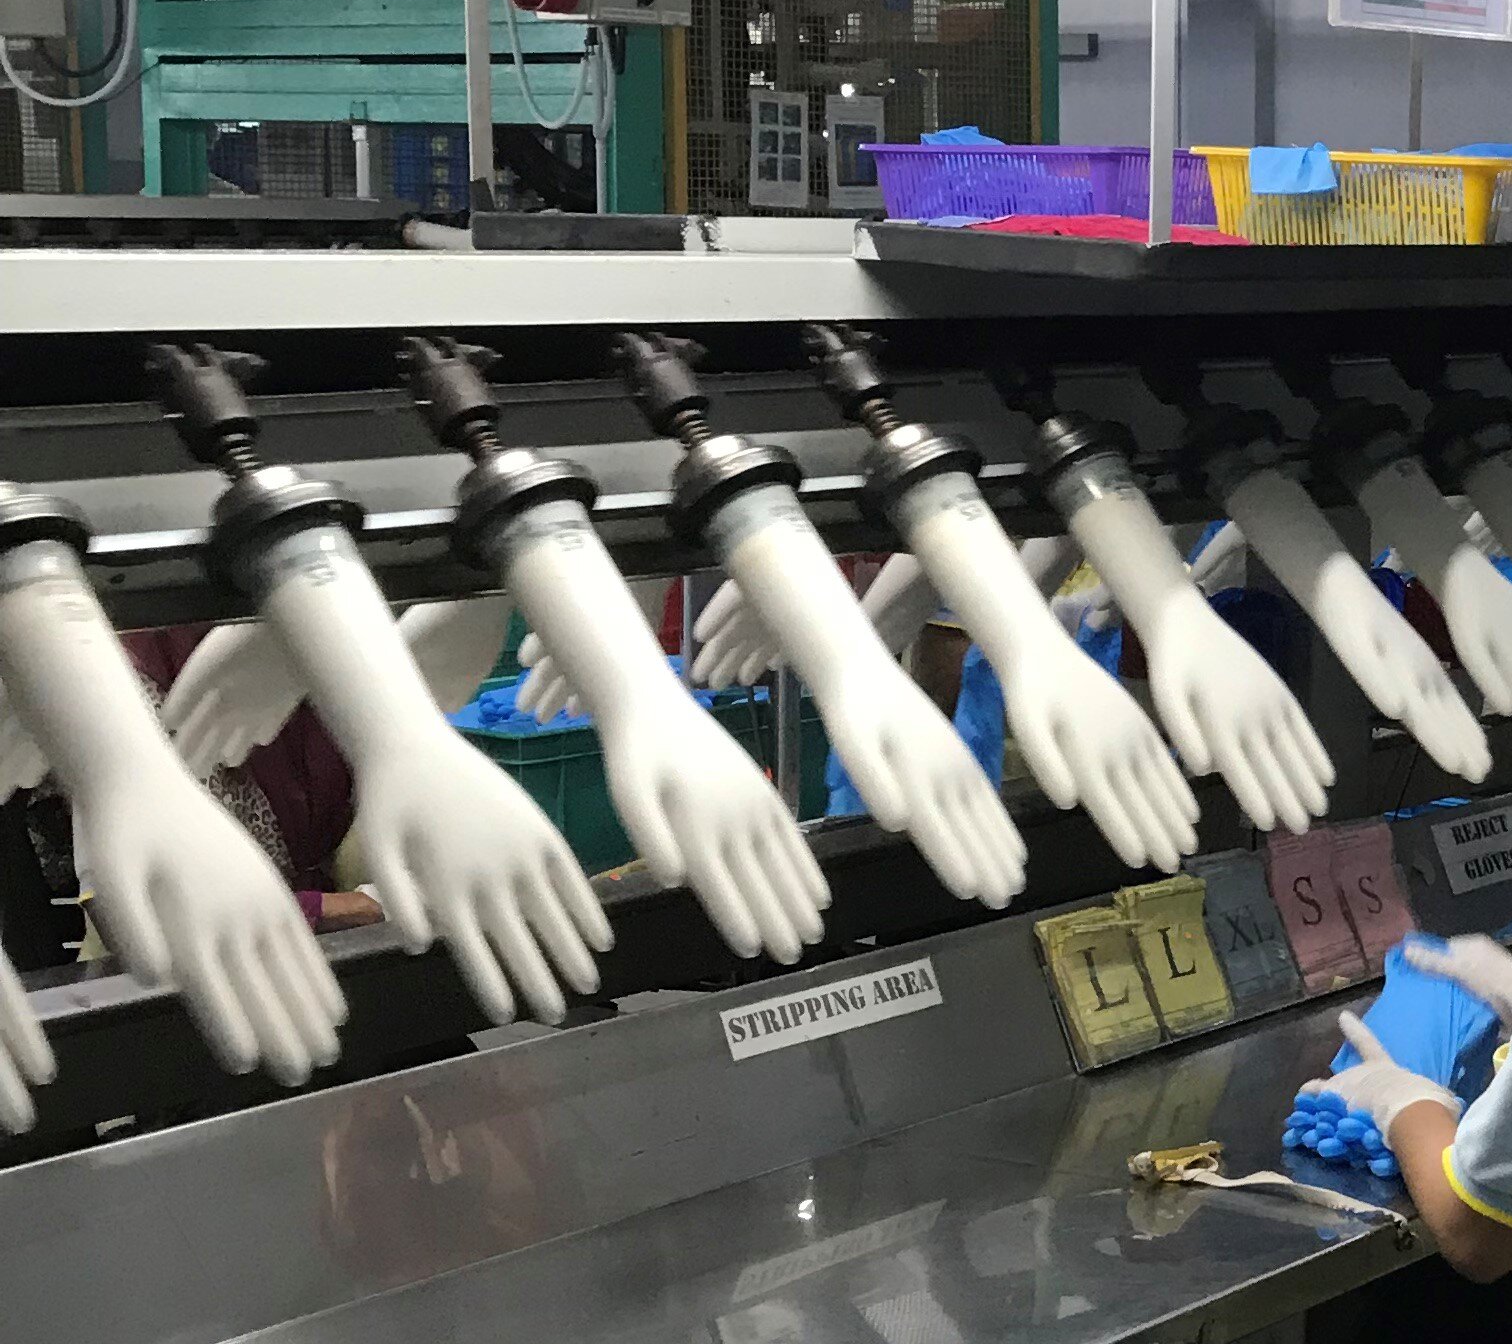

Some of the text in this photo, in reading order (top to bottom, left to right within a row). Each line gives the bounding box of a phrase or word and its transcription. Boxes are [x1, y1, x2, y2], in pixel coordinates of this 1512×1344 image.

[1450, 814, 1508, 845] REJECT
[1077, 875, 1383, 1012] L L XL S S
[727, 967, 935, 1044] STRIPPING AREA
